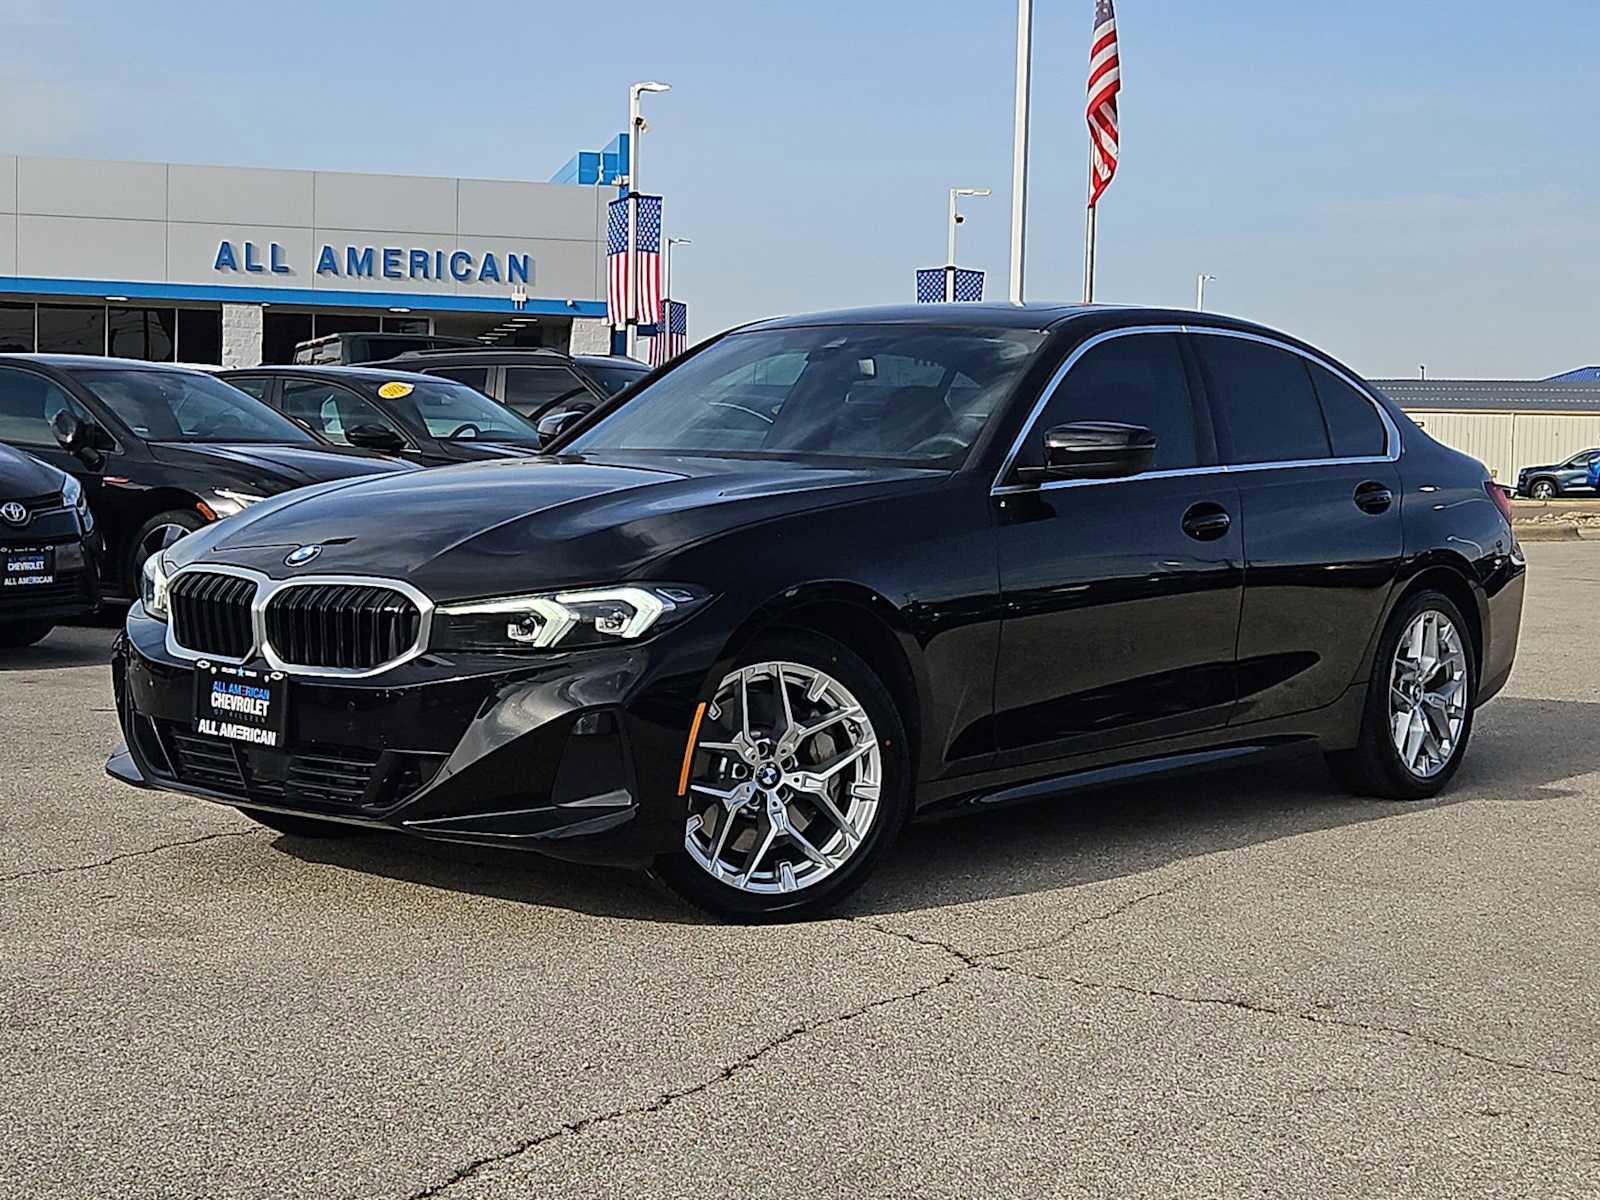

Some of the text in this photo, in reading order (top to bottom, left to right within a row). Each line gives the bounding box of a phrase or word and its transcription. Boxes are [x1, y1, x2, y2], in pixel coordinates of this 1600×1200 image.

[213, 240, 529, 284] ALL AMERICAN
[213, 681, 270, 699] ALL AMERICAN
[211, 692, 269, 716] CHEVROLET
[198, 719, 276, 746] ALL AMERICAN
